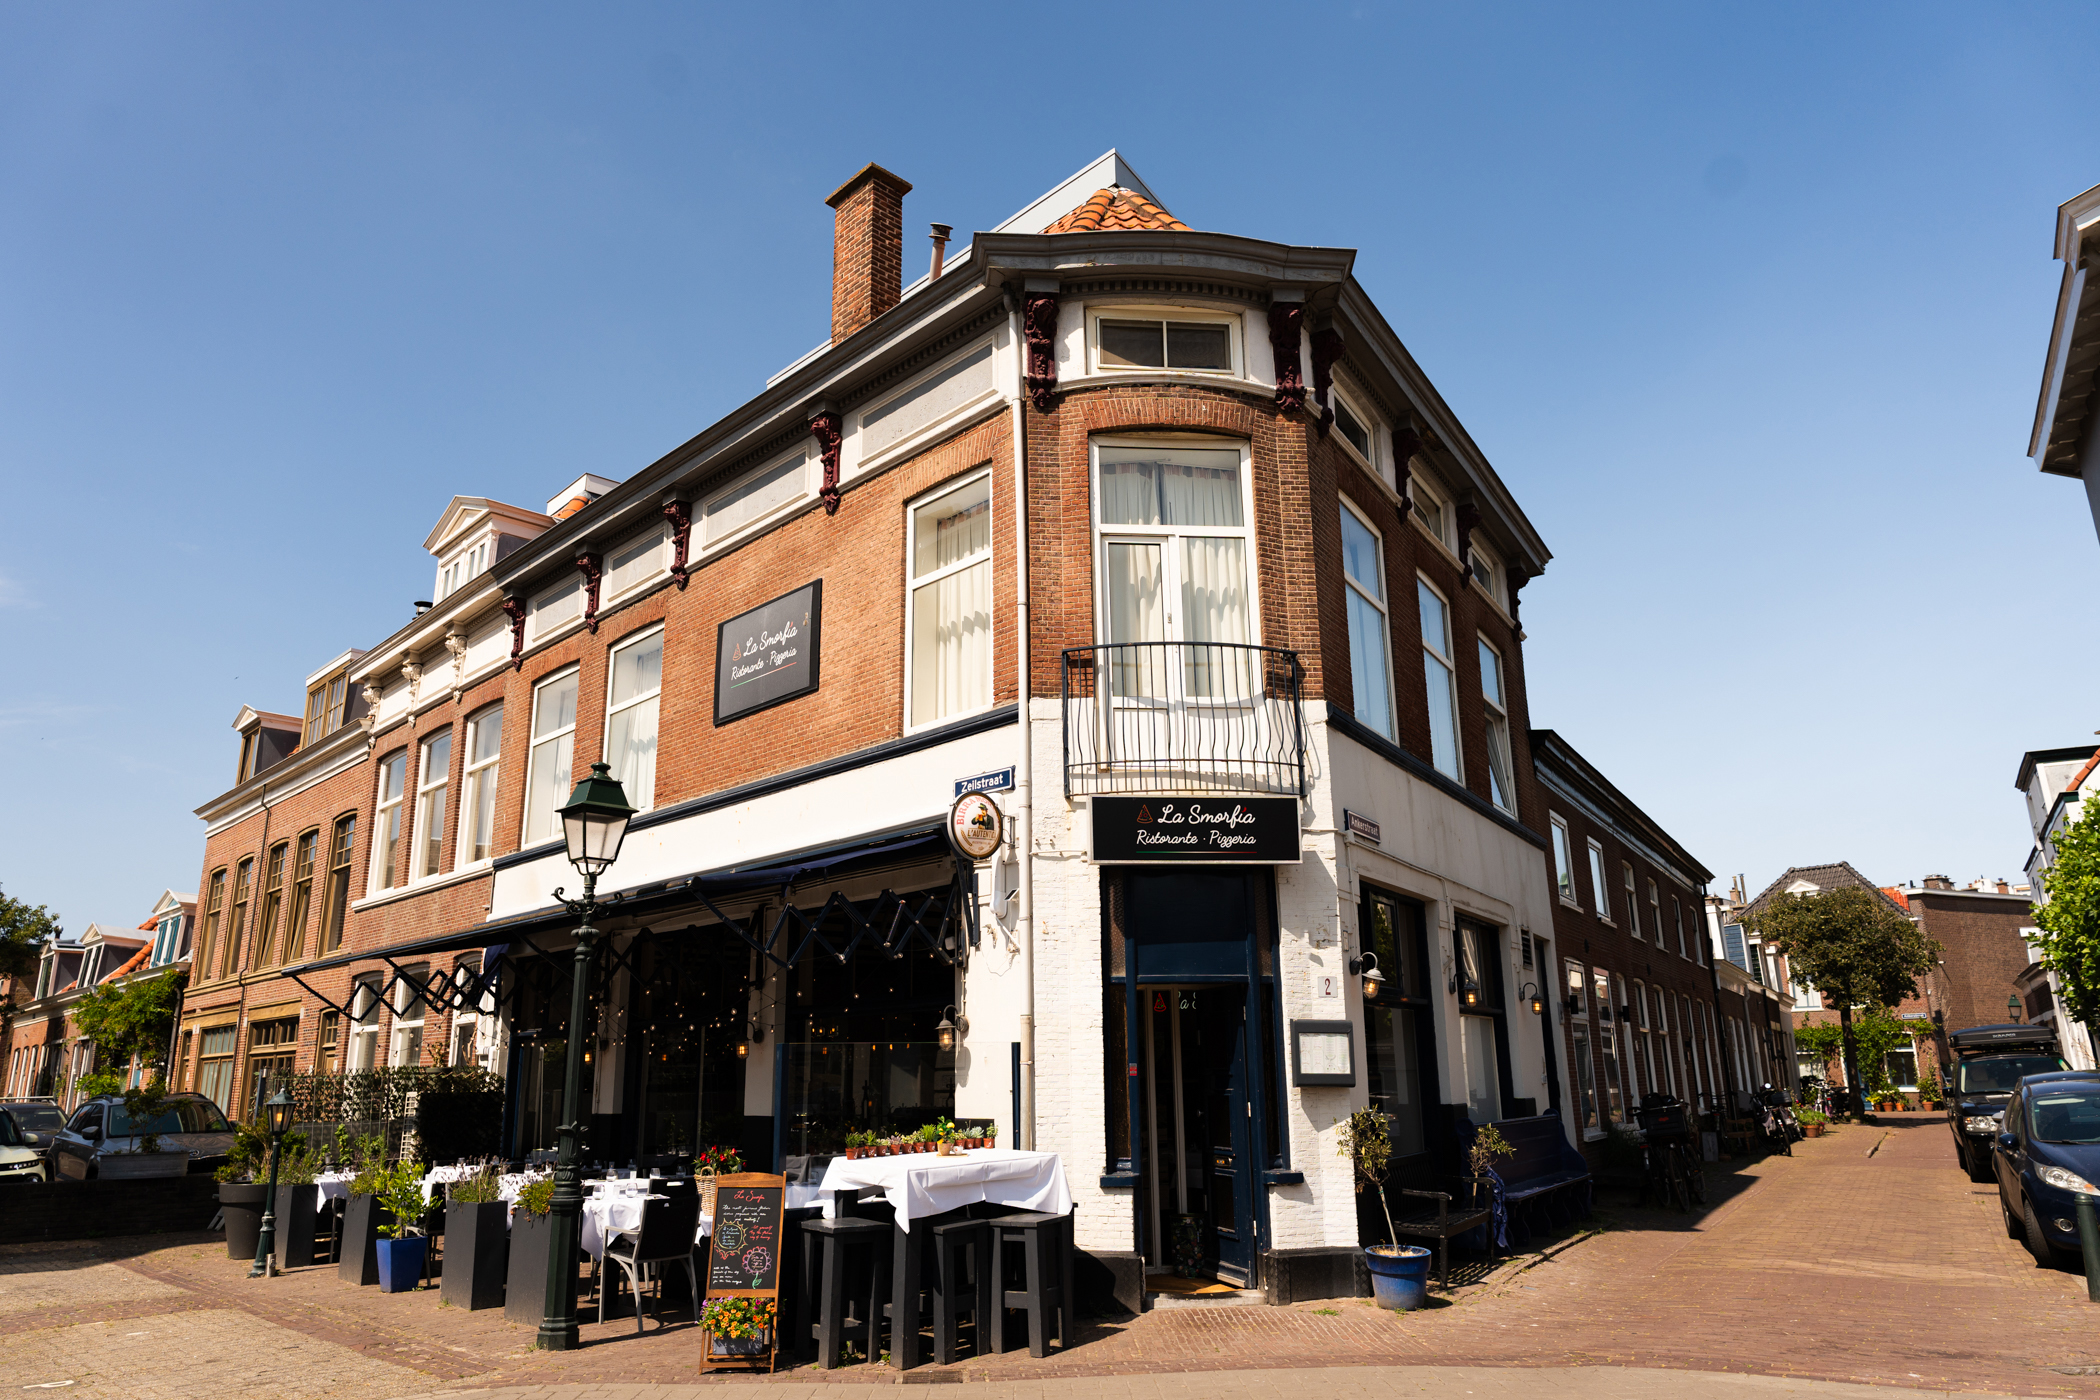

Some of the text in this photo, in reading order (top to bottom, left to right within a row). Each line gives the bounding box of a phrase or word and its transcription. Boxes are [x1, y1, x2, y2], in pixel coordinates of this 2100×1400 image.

[743, 637, 758, 657] La
[731, 647, 797, 680] Ristorante Pizzeria
[961, 774, 1003, 792] Zeilstraat
[956, 798, 976, 825] BIRRA
[1157, 804, 1185, 824] La
[1351, 816, 1379, 836] Ankerstraat
[1136, 829, 1257, 848] Ristorante Pizzeria
[1325, 978, 1331, 995] 2
